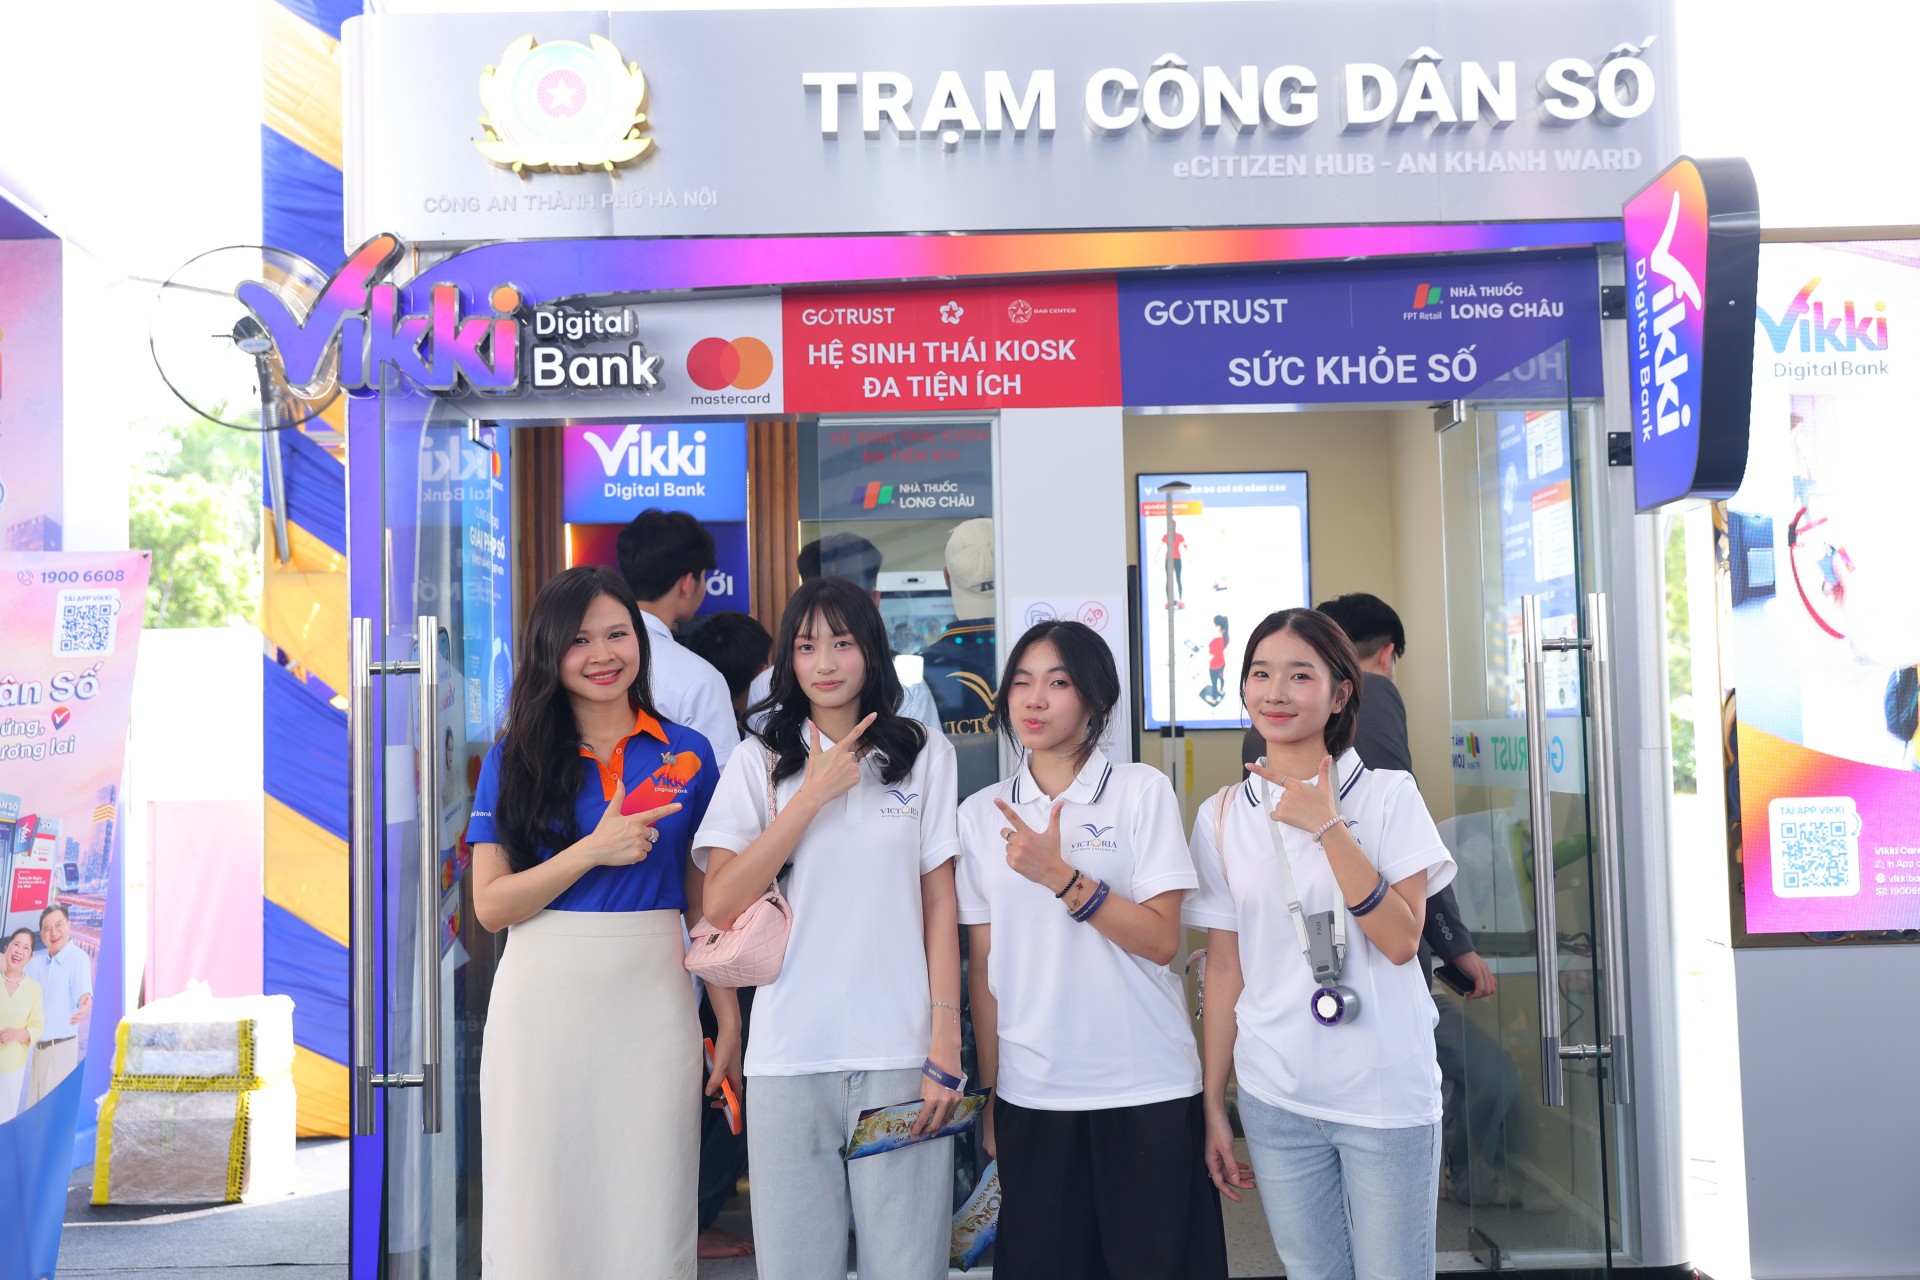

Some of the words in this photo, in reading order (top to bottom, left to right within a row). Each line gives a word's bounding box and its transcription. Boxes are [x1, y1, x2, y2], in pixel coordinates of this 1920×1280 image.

[802, 69, 1057, 153] TRẠM
[1084, 53, 1318, 134] CÔNG
[1342, 46, 1516, 130] DÂN
[1540, 36, 1658, 124] SỐ
[1173, 154, 1306, 178] eCITIZEN
[1315, 153, 1376, 176] HUB
[1396, 152, 1438, 174] AN
[1445, 150, 1546, 173] KHANH
[1554, 148, 1642, 171] WARD
[423, 192, 481, 213] CÔNG
[486, 196, 517, 212] AN
[523, 190, 596, 211] THÀNH
[601, 185, 645, 209] PHỐ
[649, 188, 678, 207] HÀ
[683, 186, 718, 212] NỘI
[1449, 283, 1478, 298] NHÀ
[1480, 281, 1524, 297] THUỐC
[235, 232, 523, 391] Vikki
[801, 307, 896, 325] GOTRUST
[1143, 298, 1288, 326] GOTRUST
[1402, 311, 1418, 320] FPT
[1419, 310, 1442, 320] Retail
[1450, 303, 1511, 320] LONG
[1513, 298, 1565, 318] CHÂU
[1634, 256, 1650, 361] Digital
[1650, 190, 1702, 437] Vikki
[1756, 276, 1889, 354] Vikki
[534, 308, 631, 342] Digital
[533, 346, 658, 387] Bank
[808, 338, 844, 370] HỆ
[851, 342, 916, 365] SINH
[922, 336, 987, 363] THÁI
[996, 339, 1077, 362] KIOSK
[1228, 350, 1305, 388] SỨC
[1316, 345, 1418, 386] KHỎE
[1427, 344, 1478, 384] SỐ
[1773, 361, 1837, 381] Digital
[1841, 359, 1890, 376] Bank
[690, 391, 771, 406] mastercard
[862, 376, 901, 398] ĐA
[906, 370, 968, 402] TIỆN
[976, 369, 1022, 396] ÍCH
[1639, 365, 1654, 442] Bank
[583, 424, 706, 477] Vikki
[604, 482, 660, 500] Digital
[663, 481, 706, 497] Bank
[899, 482, 921, 493] NHÀ
[922, 480, 958, 492] THUỐC
[899, 497, 937, 508] LONG
[938, 492, 975, 507] CHÂU
[41, 570, 79, 584] 1900
[83, 569, 125, 583] 6608
[705, 569, 734, 596] ỚI
[49, 661, 104, 703] Số
[49, 735, 75, 756] lai
[1797, 806, 1817, 815] APP
[1819, 805, 1845, 814] VIKKI
[1315, 920, 1323, 936] FAN
